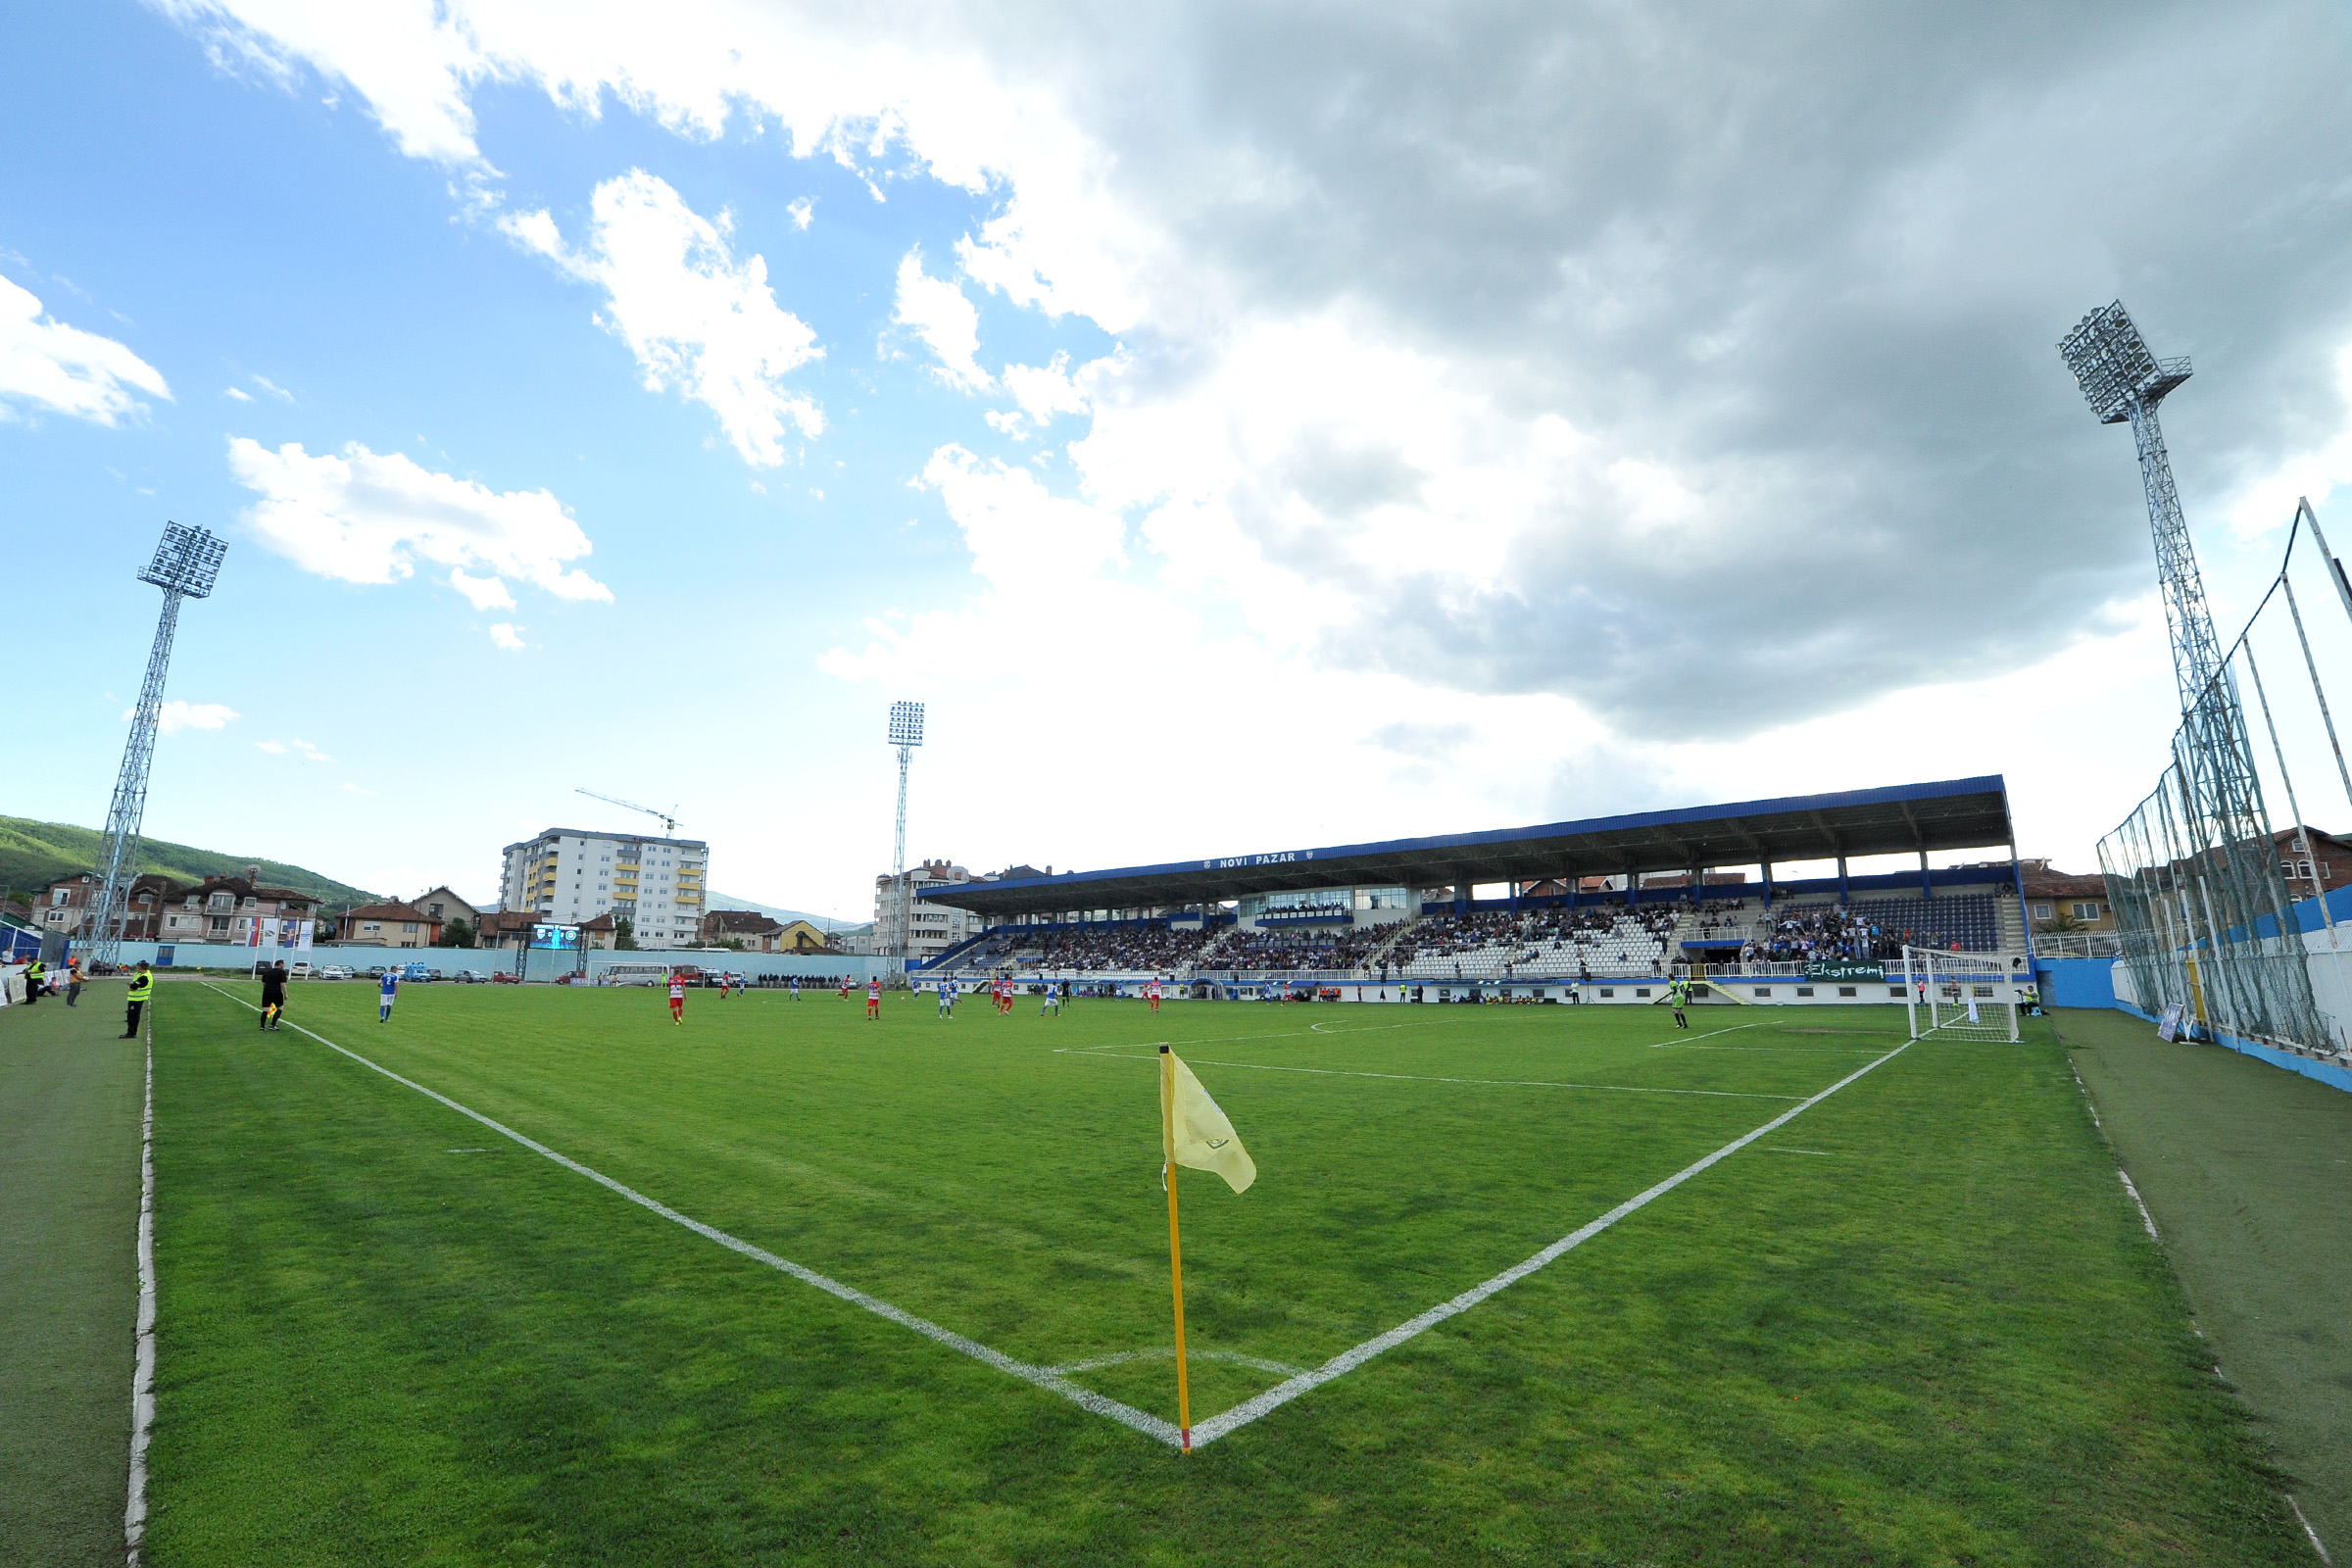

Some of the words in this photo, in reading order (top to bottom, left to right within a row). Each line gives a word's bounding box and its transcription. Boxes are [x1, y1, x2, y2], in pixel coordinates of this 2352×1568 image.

[1220, 858, 1248, 868] NOVI
[1255, 853, 1296, 864] PAZAR
[386, 976, 392, 985] 2
